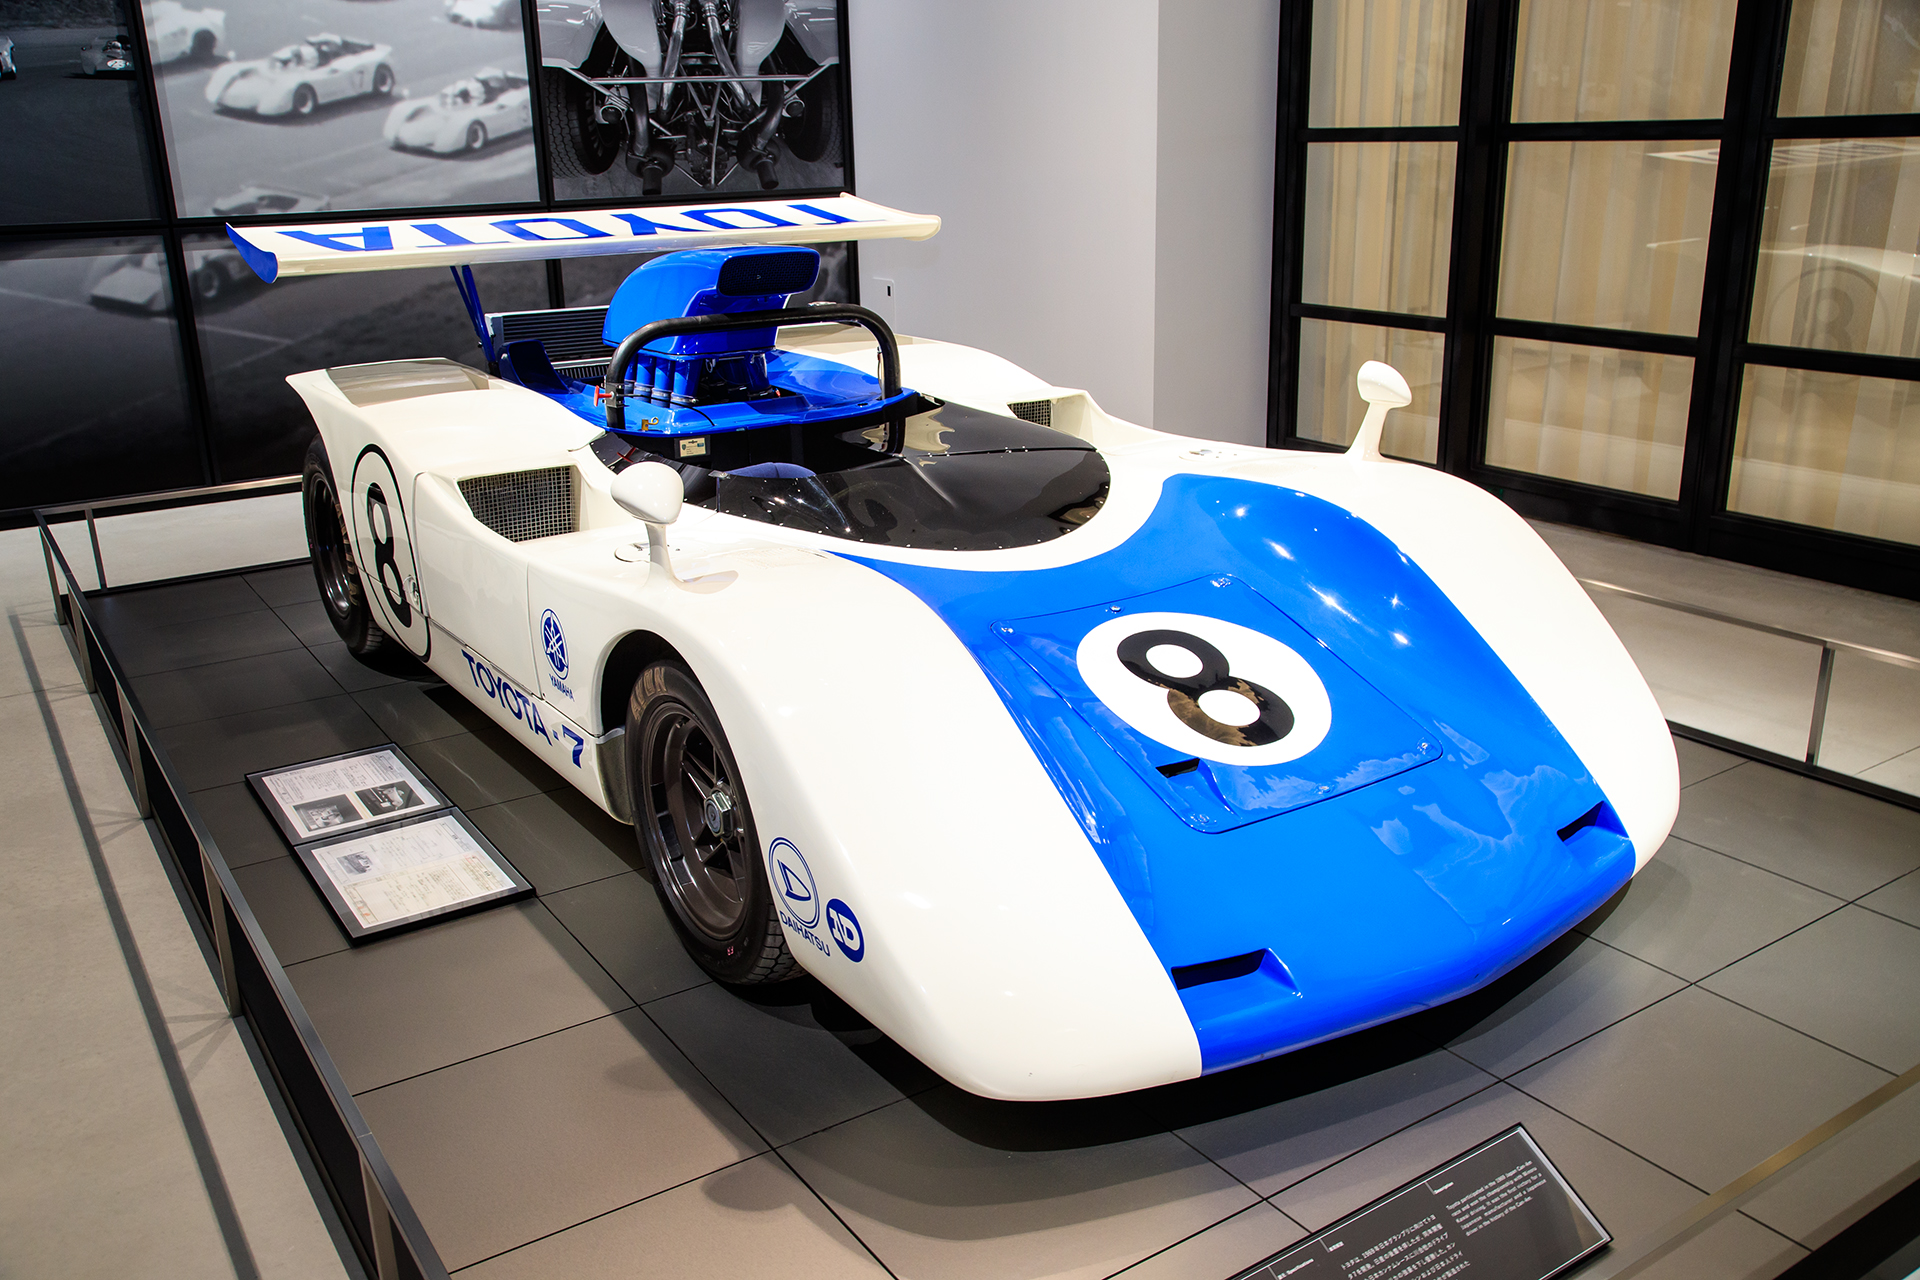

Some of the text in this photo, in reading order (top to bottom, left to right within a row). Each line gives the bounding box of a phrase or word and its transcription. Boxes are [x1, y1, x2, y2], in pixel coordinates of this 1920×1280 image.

[276, 203, 885, 252] TOYOTA
[367, 482, 412, 628] 8
[549, 674, 575, 702] YAMAHA
[1117, 629, 1295, 747] 8
[779, 910, 830, 957] DAIHATSU
[1445, 1200, 1460, 1209] Toyota
